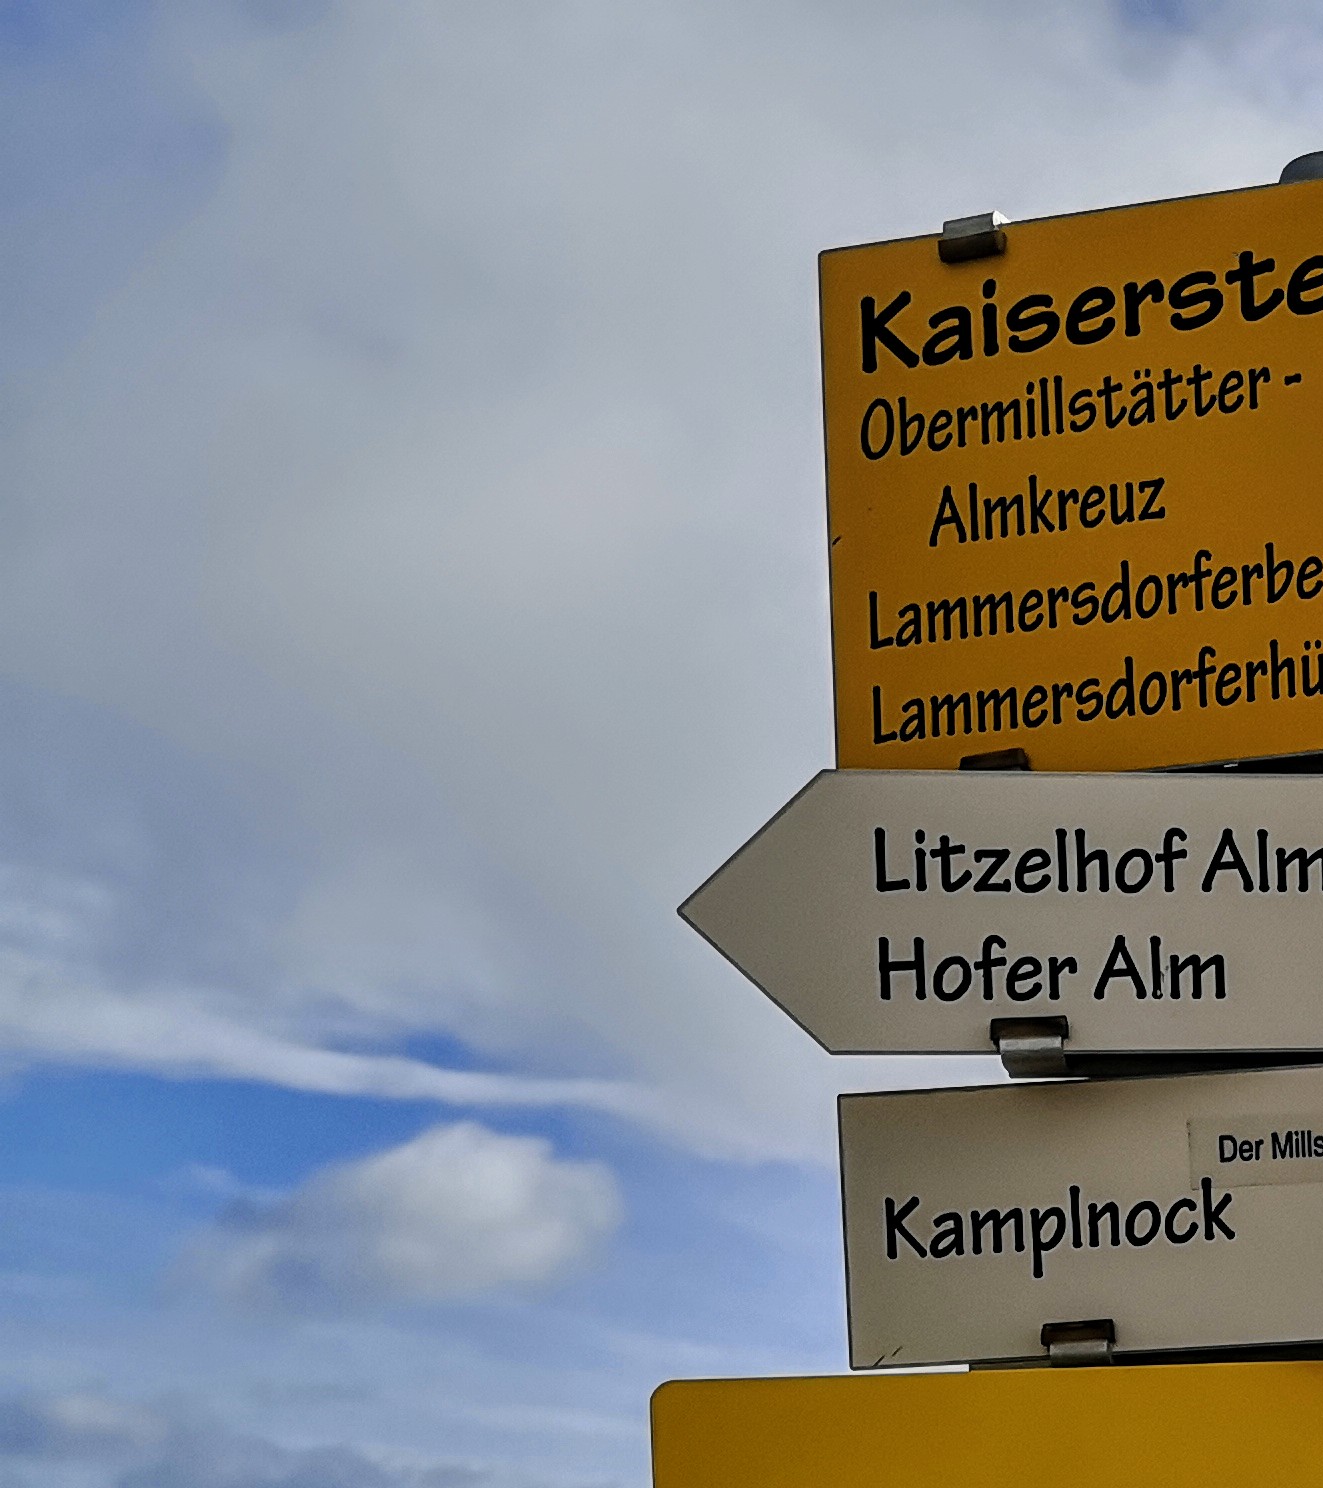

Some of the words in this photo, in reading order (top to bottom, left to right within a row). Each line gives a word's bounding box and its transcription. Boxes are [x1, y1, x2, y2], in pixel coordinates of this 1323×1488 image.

[929, 475, 1165, 547] Almkreuz
[875, 827, 1187, 893] Litzelhof
[879, 935, 1077, 1001] Hofer
[1094, 935, 1226, 1000] Alm
[1219, 1135, 1264, 1163] Der
[885, 1177, 1235, 1278] Kamplnock
